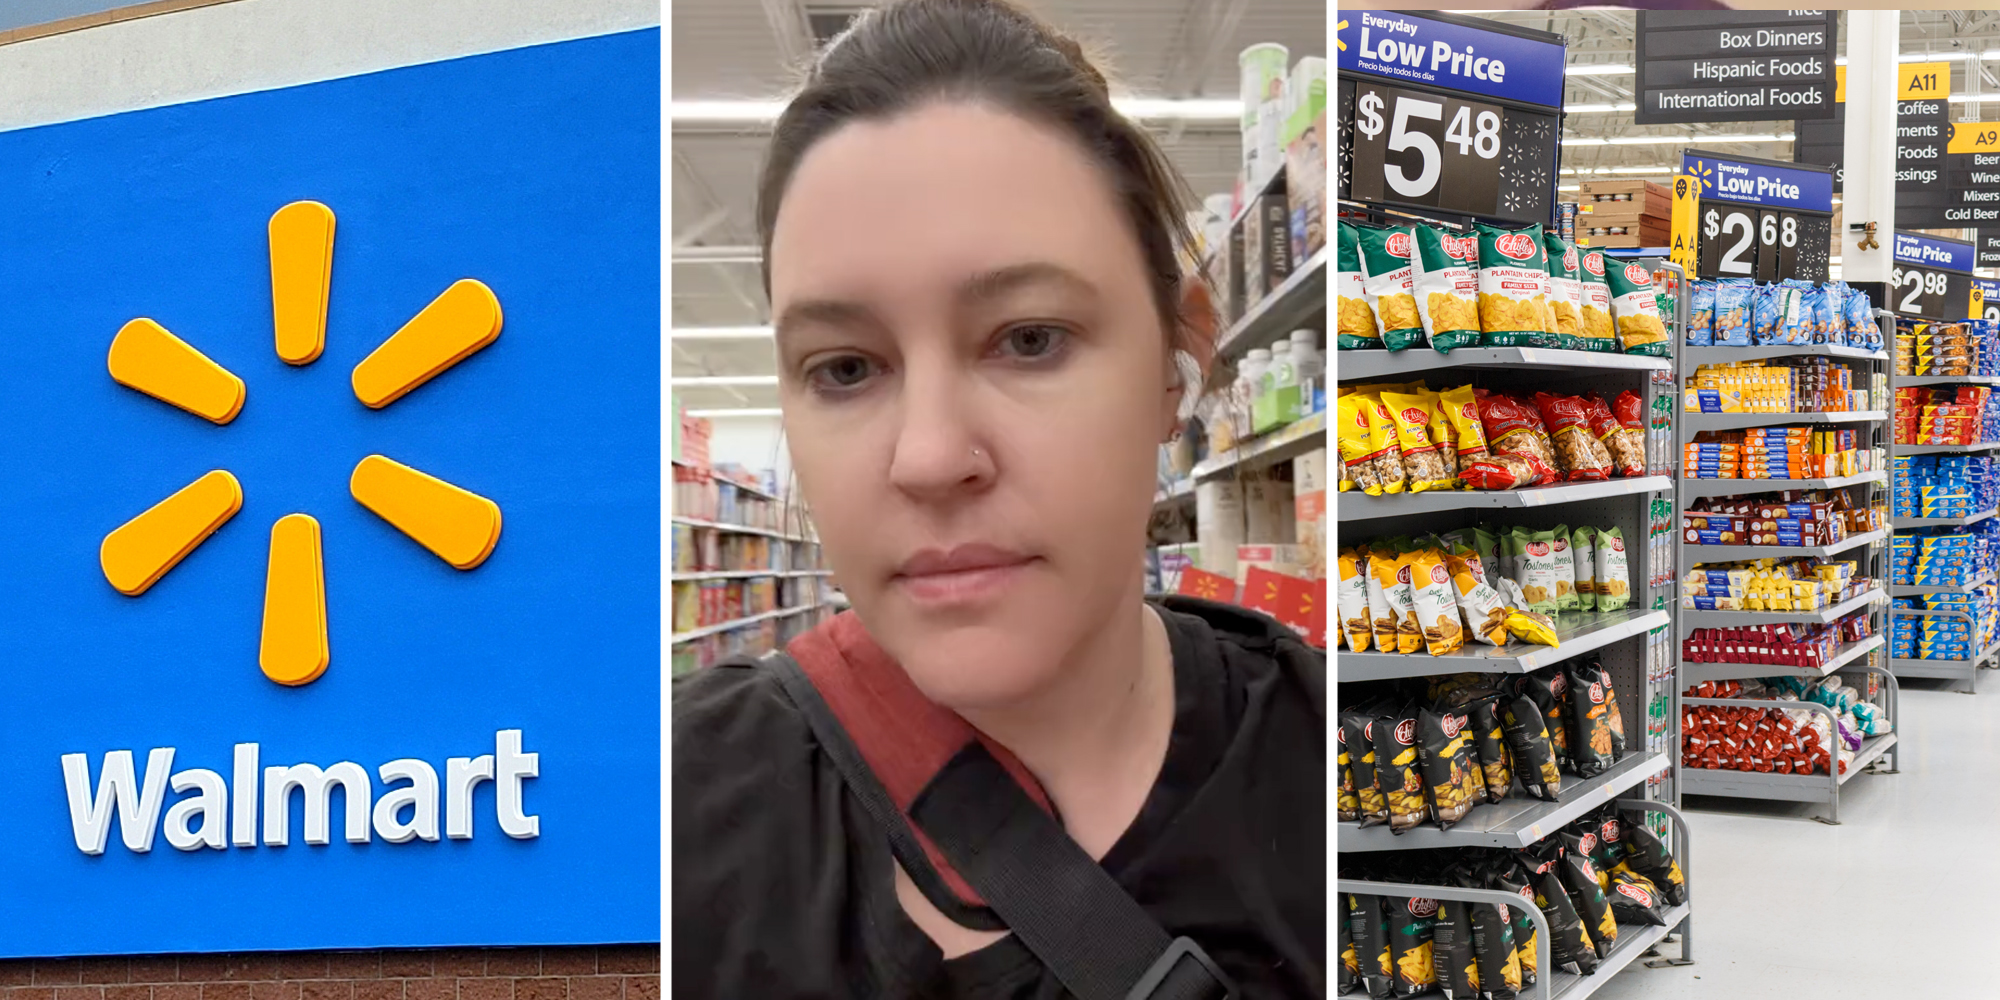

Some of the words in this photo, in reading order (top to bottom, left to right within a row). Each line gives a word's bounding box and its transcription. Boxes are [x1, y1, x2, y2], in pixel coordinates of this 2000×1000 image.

[1361, 12, 1418, 37] Everyday
[1720, 31, 1752, 49] Box
[1756, 29, 1823, 47] Dinners
[1359, 27, 1426, 68] Low
[1430, 40, 1506, 84] Price
[1357, 59, 1378, 72] Precio
[1378, 63, 1393, 75] bajo
[1393, 67, 1412, 77] todos
[1412, 69, 1421, 79] los
[1694, 60, 1765, 82] Hispanic
[1770, 57, 1823, 76] Foods
[1908, 73, 1936, 92] A11
[1659, 88, 1765, 109] International
[1770, 87, 1823, 106] Foods
[1897, 101, 1939, 115] Coffee
[1975, 130, 1997, 146] A9
[1898, 144, 1938, 159] Foods
[1974, 154, 2000, 165] Beer
[1717, 163, 1749, 176] Everyday
[1971, 172, 2000, 183] Wine
[1717, 172, 1755, 195] Low
[1757, 176, 1800, 200] Price
[1963, 190, 2000, 202] Mixers
[1944, 208, 1971, 220] Cold
[1973, 208, 1999, 220] Beer
[1673, 233, 1684, 251] A
[1897, 235, 1919, 245] Everyday
[1895, 241, 1922, 258] Low
[1922, 245, 1953, 263] Price
[1491, 270, 1523, 278] PLANTAIN
[1522, 558, 1554, 571] Tostones
[61, 729, 541, 856] Walmart
